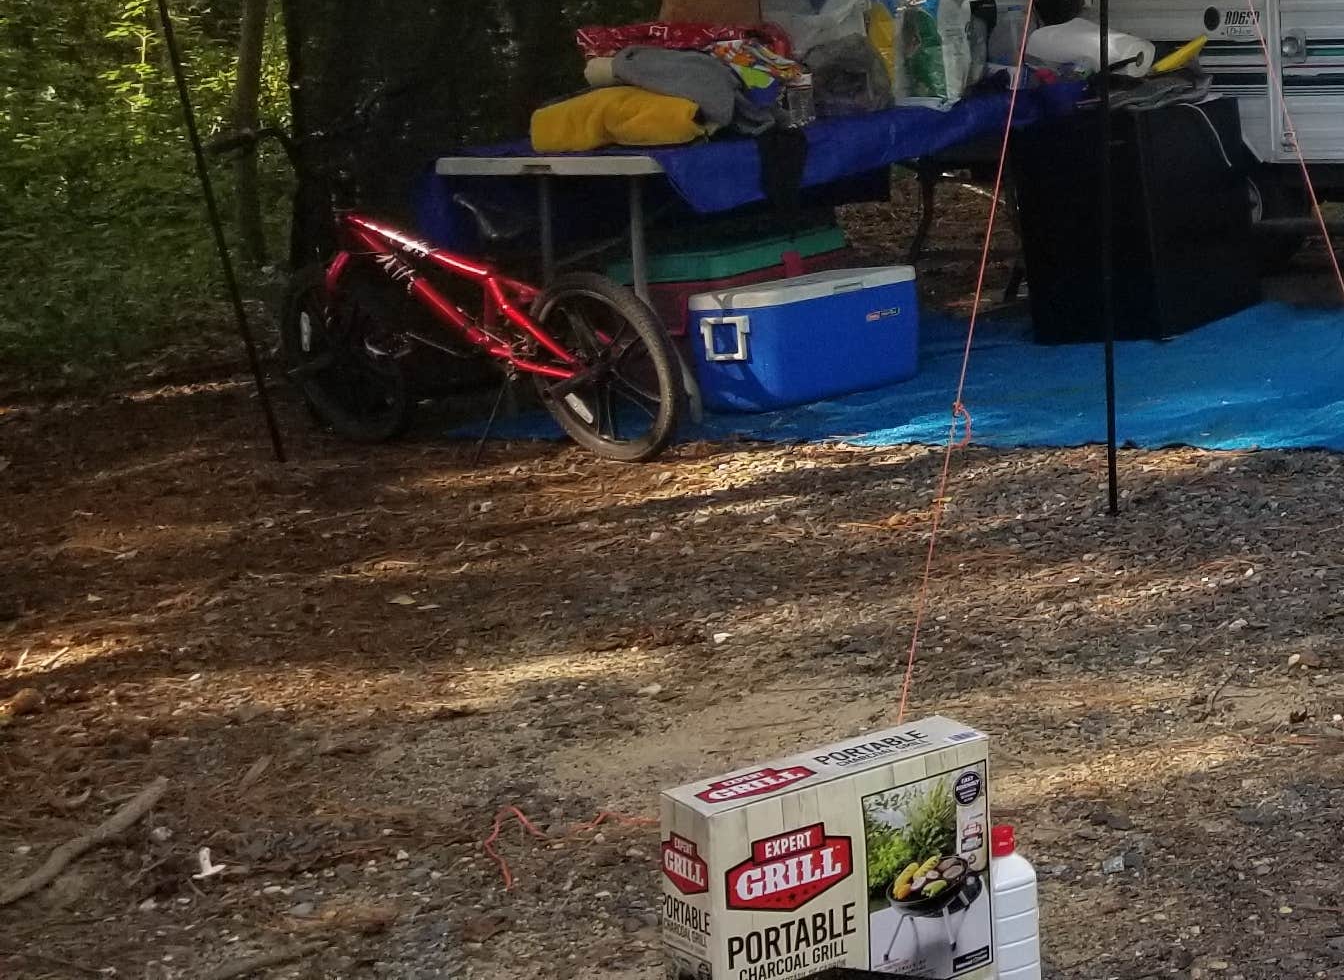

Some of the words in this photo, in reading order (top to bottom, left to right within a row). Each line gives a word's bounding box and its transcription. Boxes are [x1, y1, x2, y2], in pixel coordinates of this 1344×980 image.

[813, 729, 928, 765] PORTABLE
[708, 771, 805, 800] GRILL
[721, 772, 765, 787] EXPERT
[674, 837, 693, 856] EXPERT
[764, 831, 812, 859] EXPERT
[664, 848, 705, 887] GRILL
[736, 847, 842, 901] GRILL
[663, 892, 711, 937] PORTABLE
[727, 901, 857, 970] PORTABLE
[739, 951, 810, 980] CHARCOAL
[812, 939, 848, 964] GRILL
